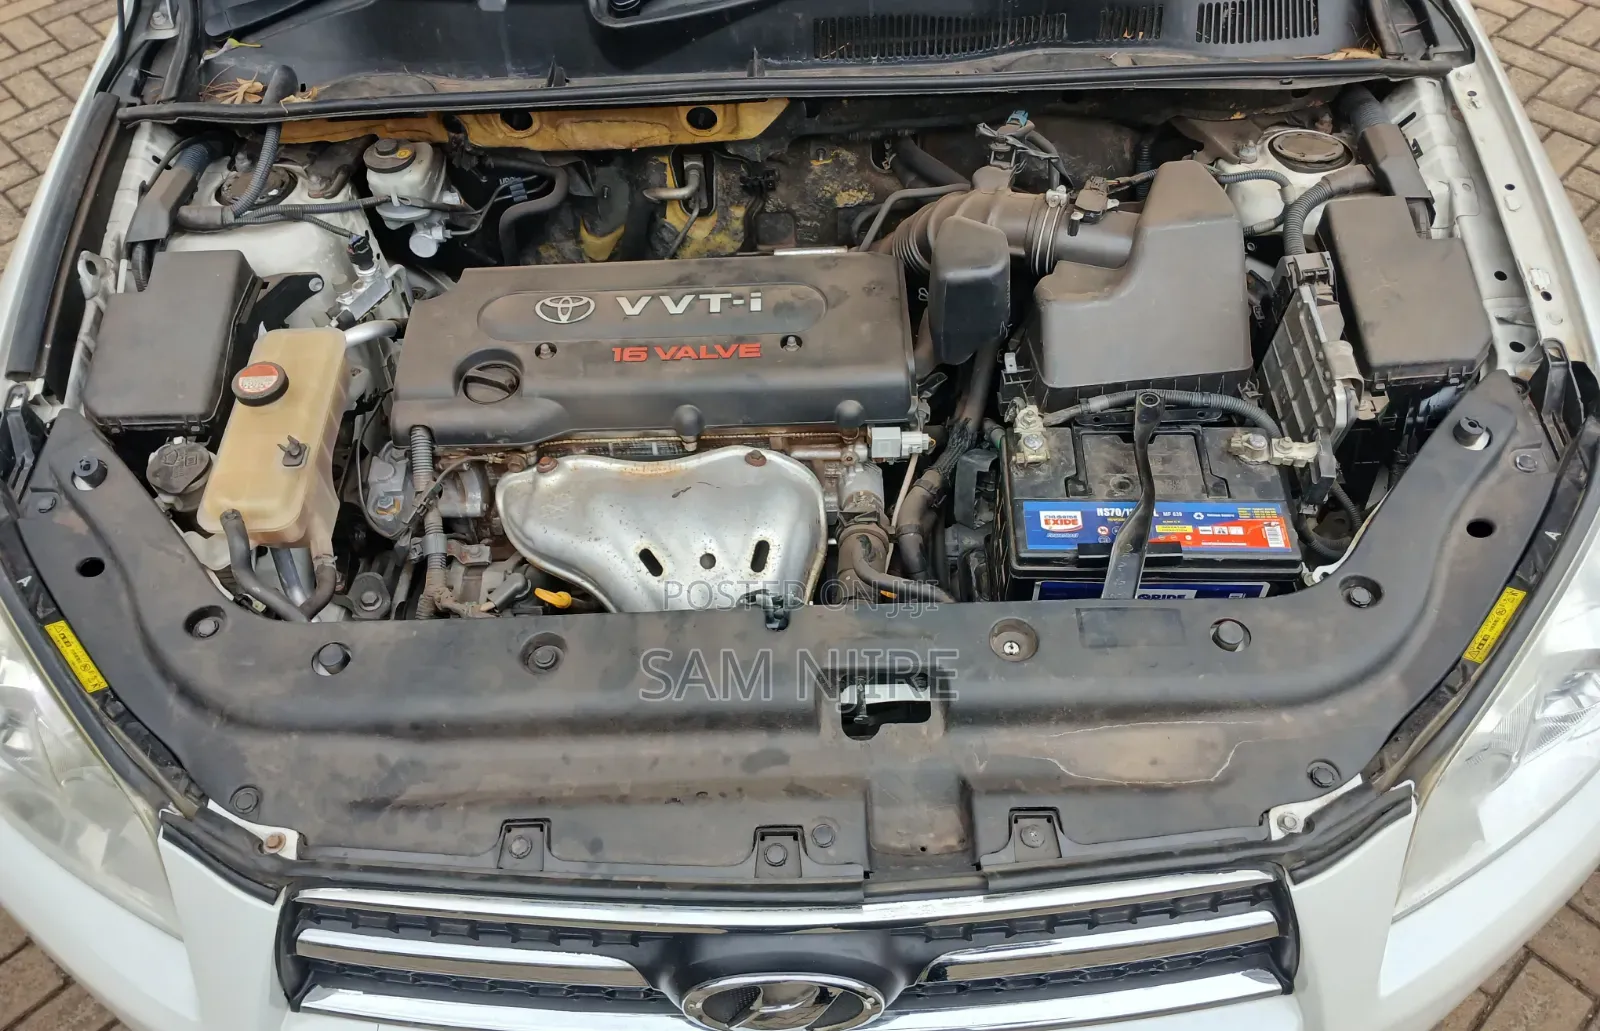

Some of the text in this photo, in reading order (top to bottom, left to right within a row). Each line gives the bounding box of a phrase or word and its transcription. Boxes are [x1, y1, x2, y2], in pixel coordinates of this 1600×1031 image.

[612, 343, 762, 362] 16 VALVE
[1044, 518, 1079, 526] EXIDE
